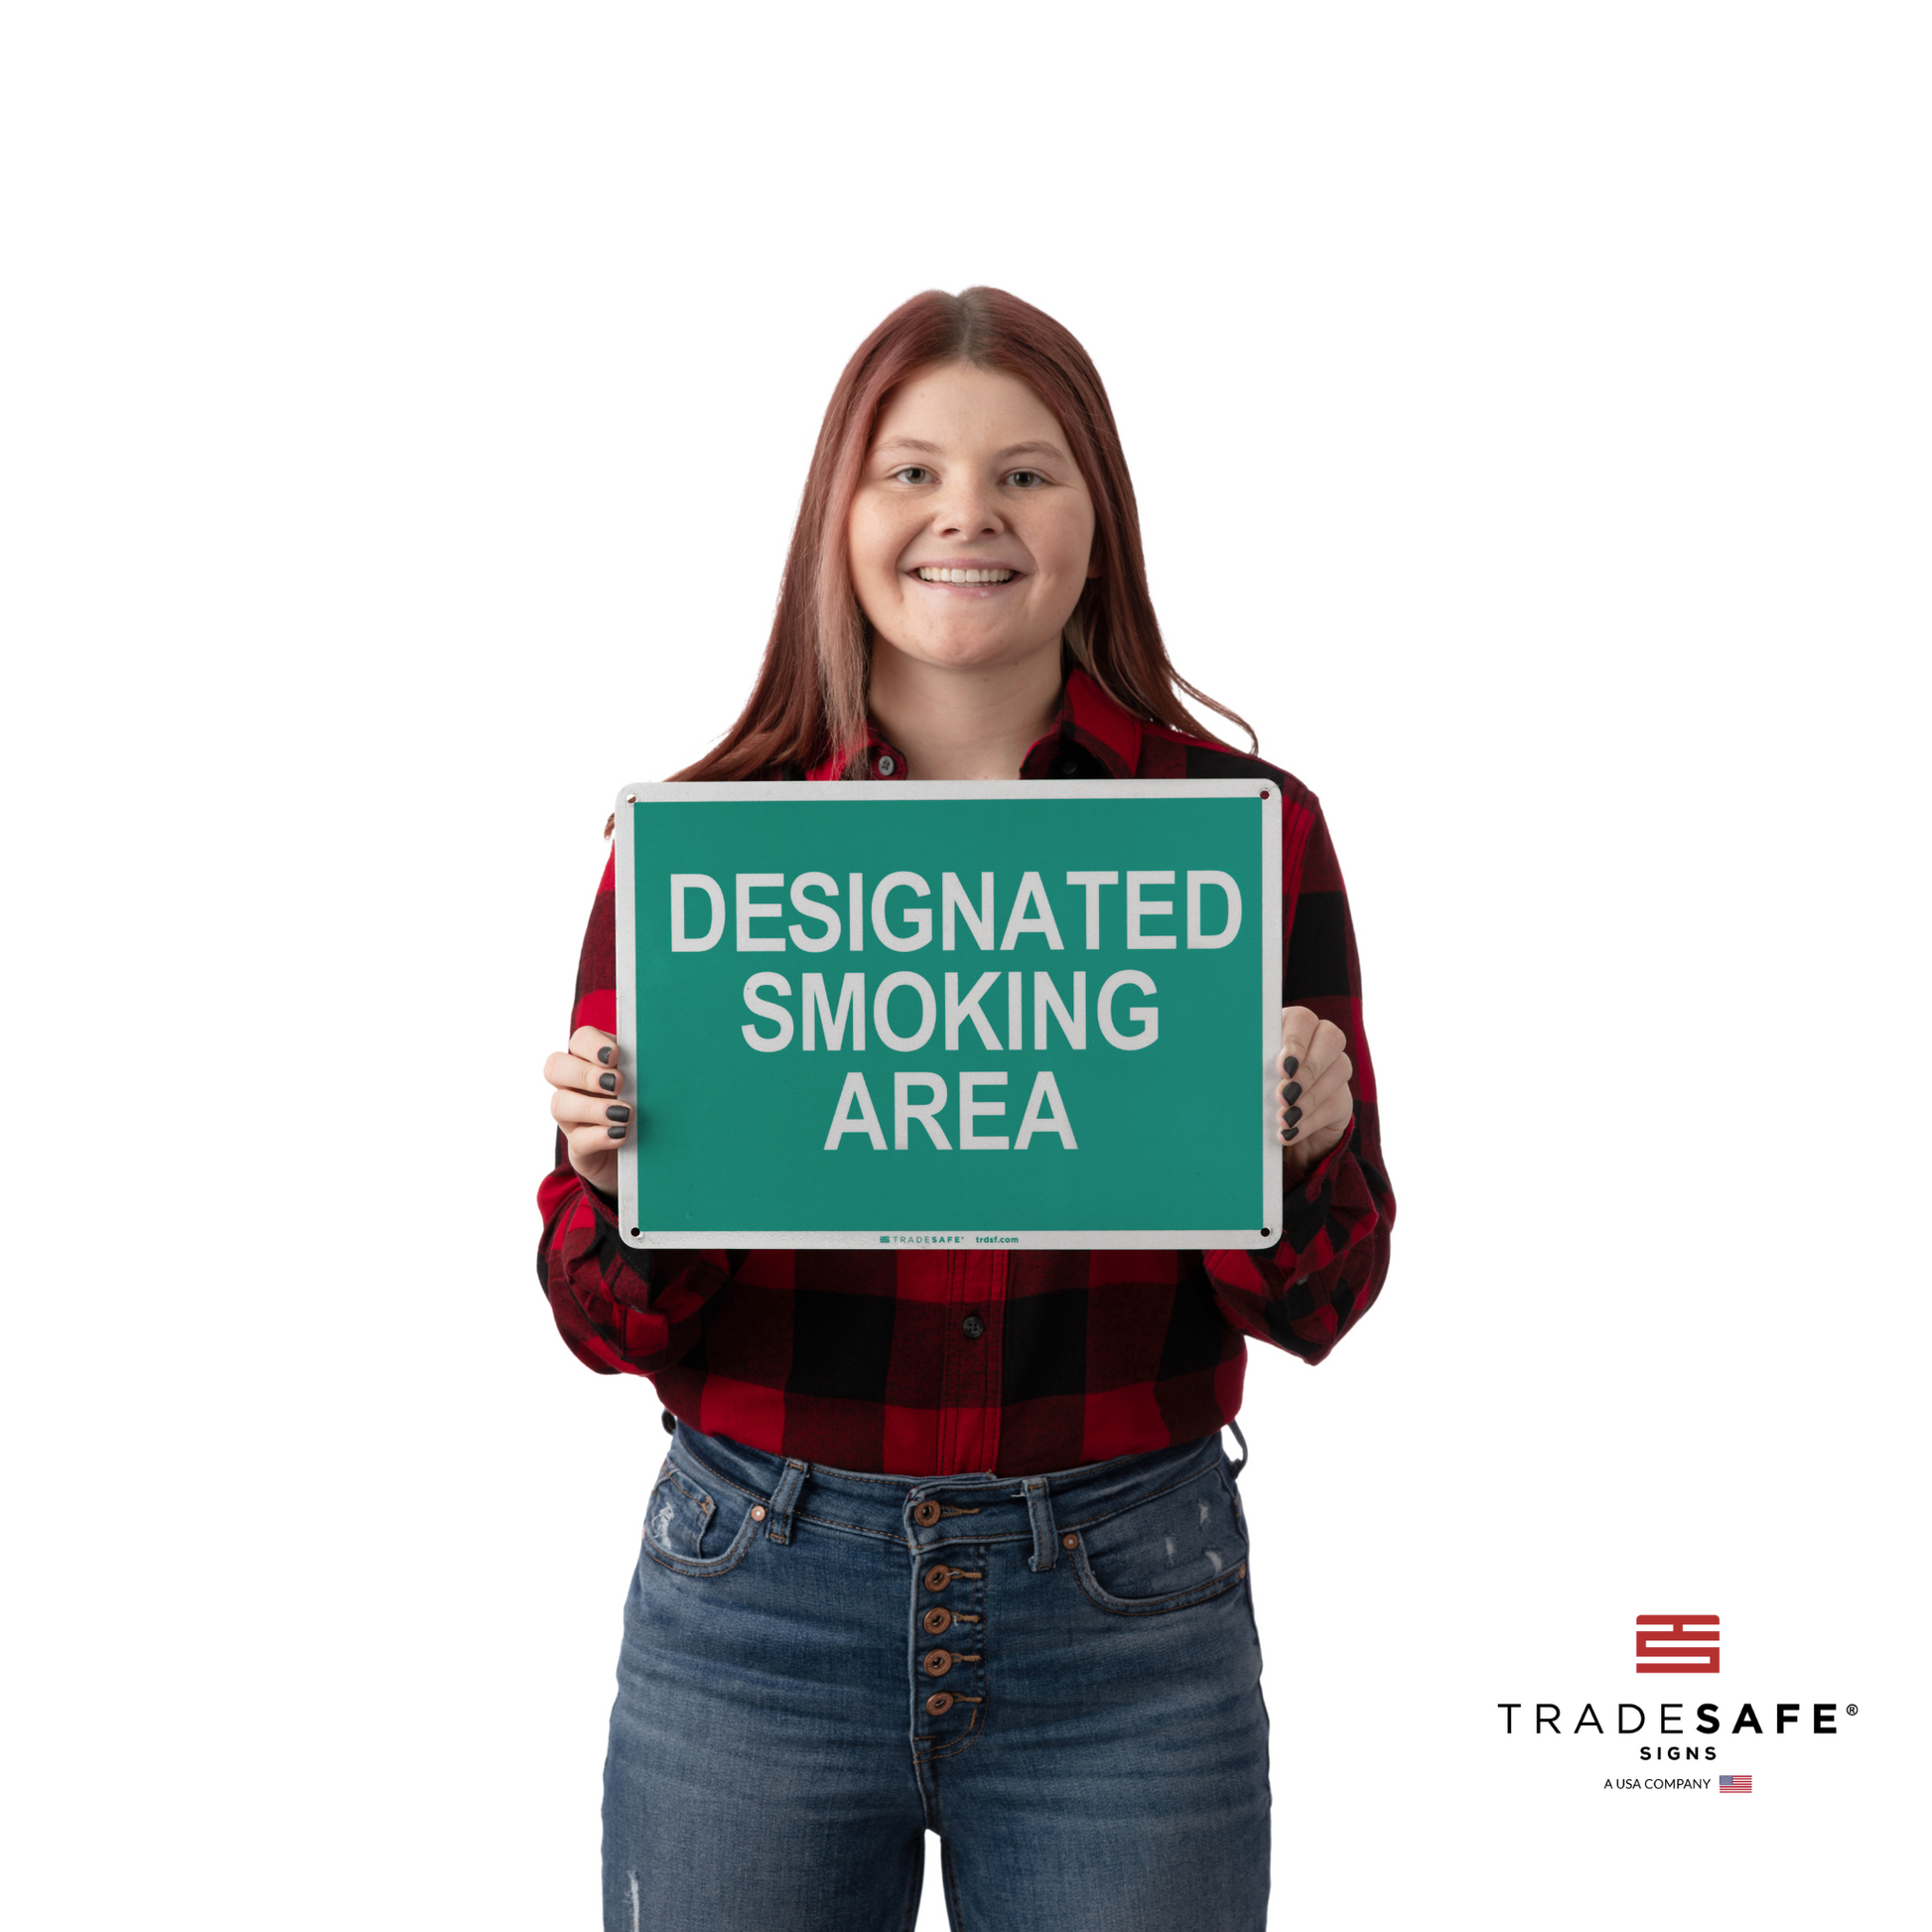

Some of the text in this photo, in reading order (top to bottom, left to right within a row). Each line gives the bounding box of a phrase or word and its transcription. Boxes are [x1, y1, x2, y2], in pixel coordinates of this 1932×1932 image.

[670, 870, 1243, 953] DESIGNATED
[741, 969, 1159, 1052] SMOKING
[823, 1070, 1078, 1151] AREA
[975, 1235, 1020, 1244] trdsf.com
